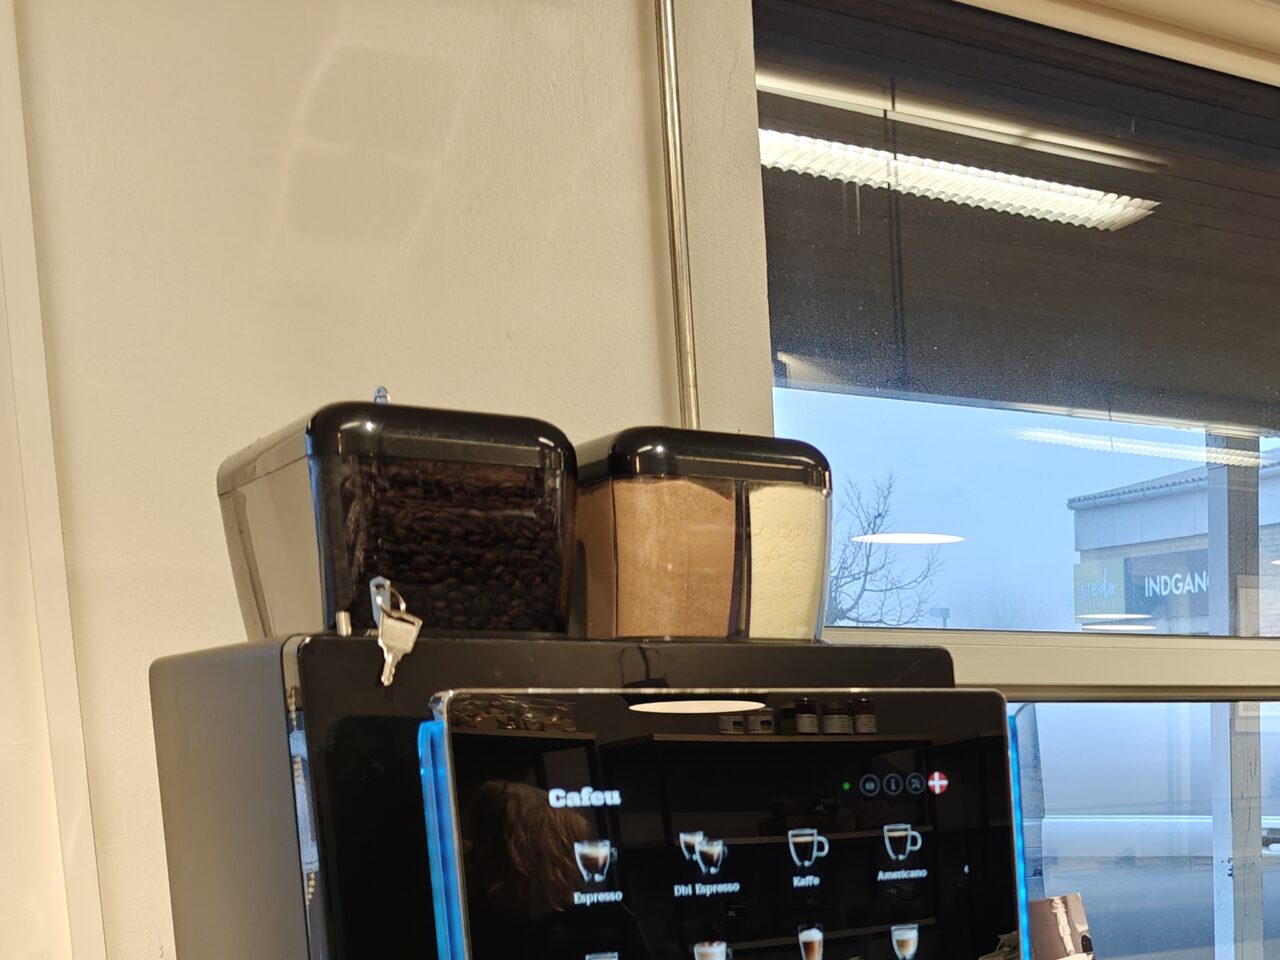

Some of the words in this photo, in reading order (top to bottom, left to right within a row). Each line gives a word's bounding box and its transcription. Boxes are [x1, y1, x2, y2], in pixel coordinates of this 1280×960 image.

[1145, 570, 1209, 598] INDGAN
[548, 785, 623, 808] Cafeu
[792, 875, 820, 888] Kaffe
[877, 868, 928, 882] Americano
[674, 884, 692, 897] Dbl
[695, 882, 740, 897] Espresso
[573, 891, 623, 907] Espresso
